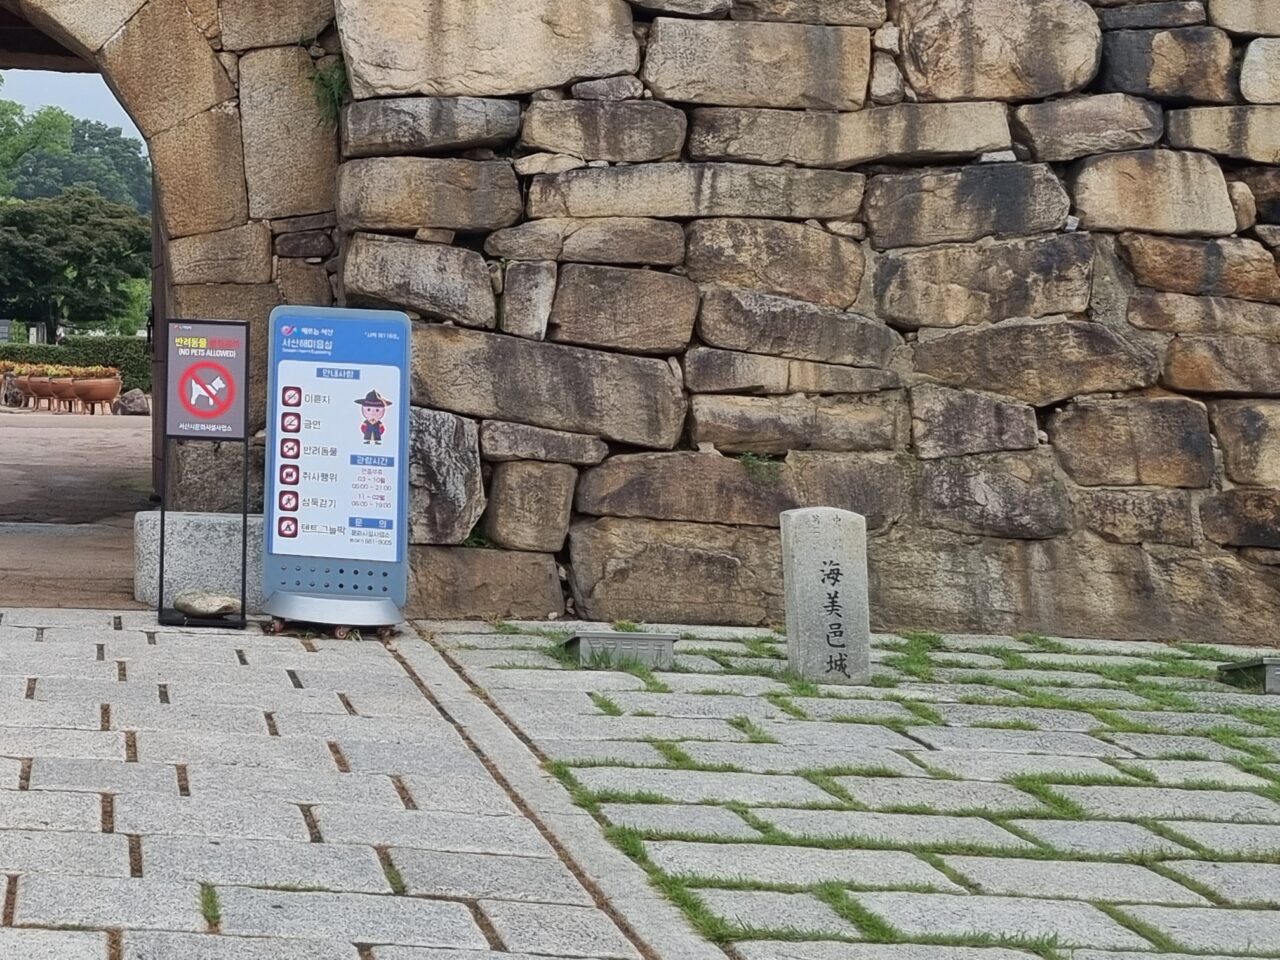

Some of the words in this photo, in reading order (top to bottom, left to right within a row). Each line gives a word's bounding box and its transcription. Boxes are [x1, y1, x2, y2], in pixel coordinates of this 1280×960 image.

[282, 338, 333, 350] 서산해미읍성
[191, 348, 205, 356] PETS
[206, 349, 236, 358] ALLOWED)
[303, 419, 321, 430] 금연
[303, 446, 337, 456] 반려동물
[303, 472, 338, 482] 취사행위
[820, 560, 851, 679] 海美邑城
